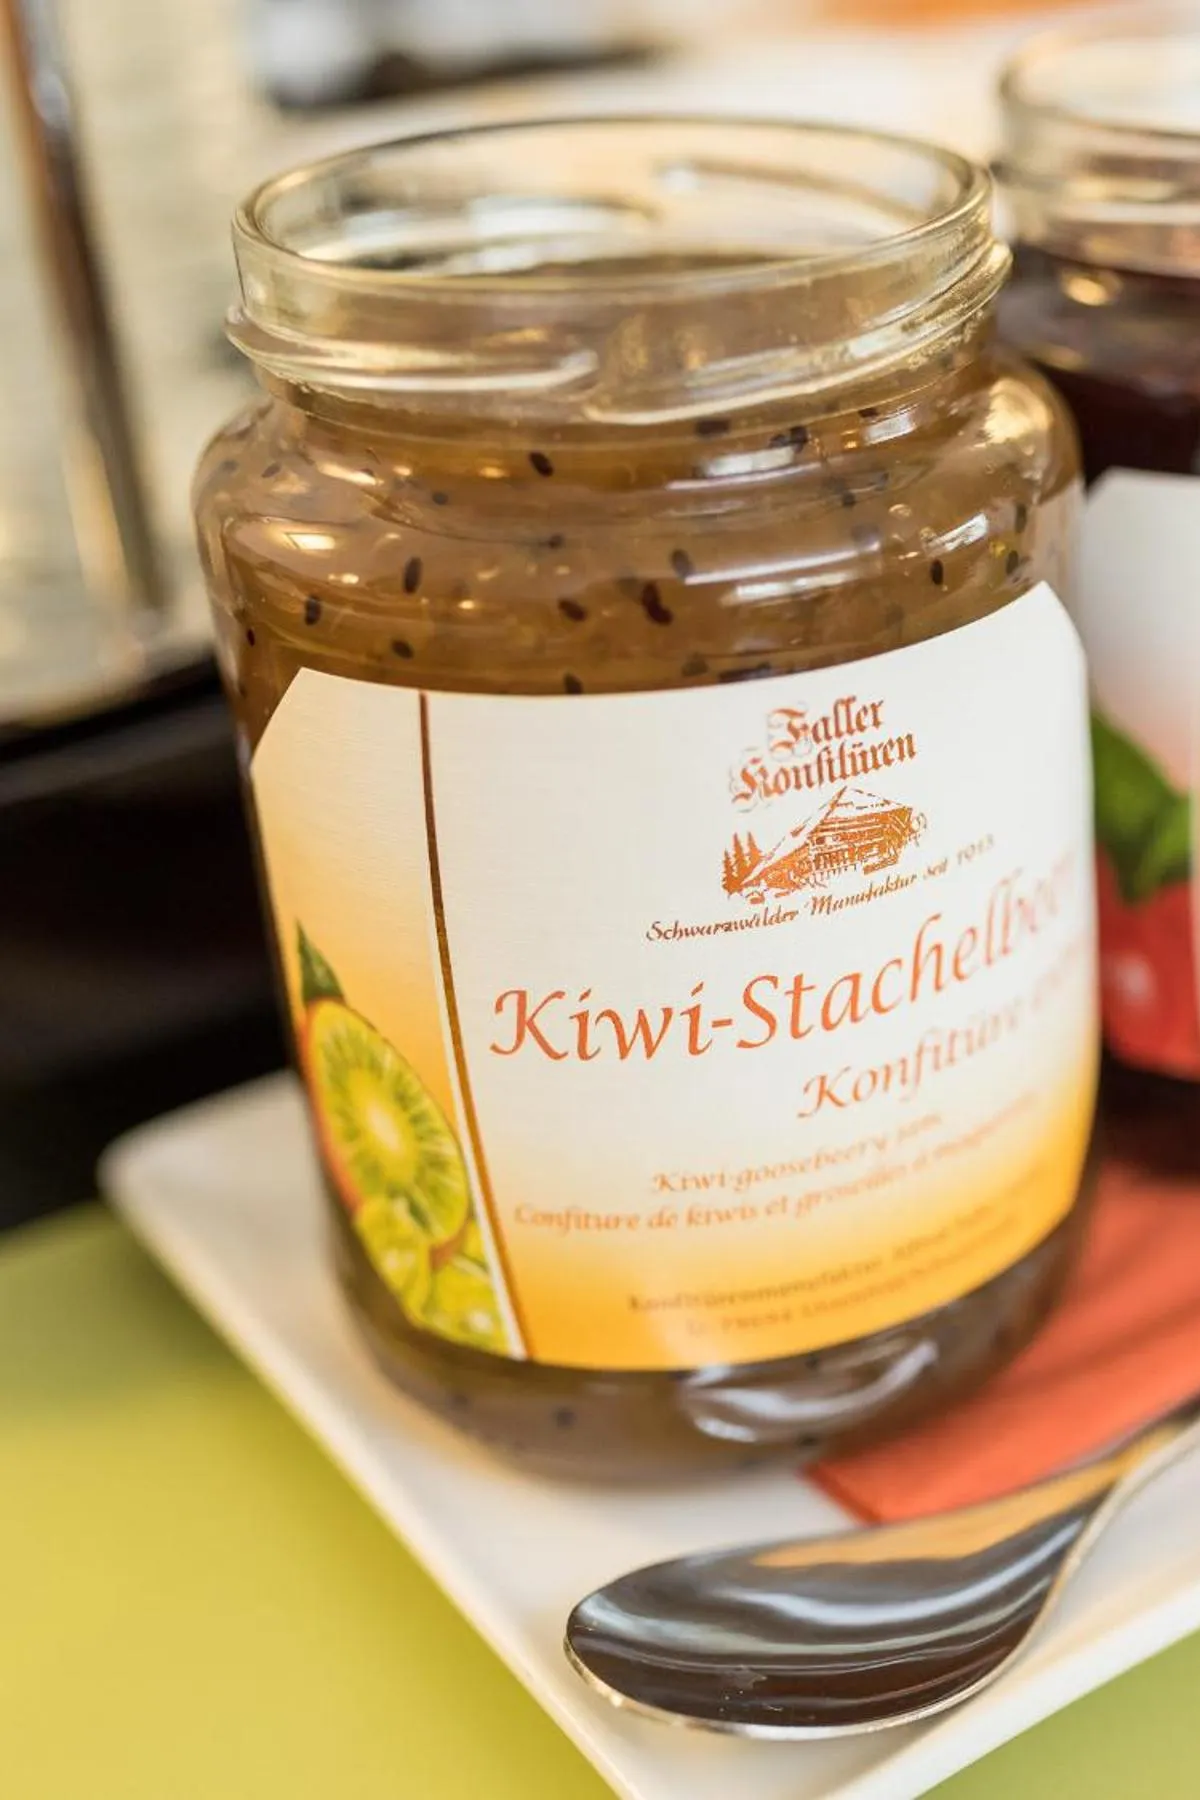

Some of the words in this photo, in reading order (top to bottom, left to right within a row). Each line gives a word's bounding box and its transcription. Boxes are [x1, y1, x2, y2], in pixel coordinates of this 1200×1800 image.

[765, 695, 884, 760] Faller
[730, 734, 917, 812] Konfitüren
[645, 904, 799, 941] Schwarzwälder
[804, 872, 918, 917] Manufaktur
[797, 994, 1026, 1119] Konfitüre
[647, 1204, 677, 1230] de
